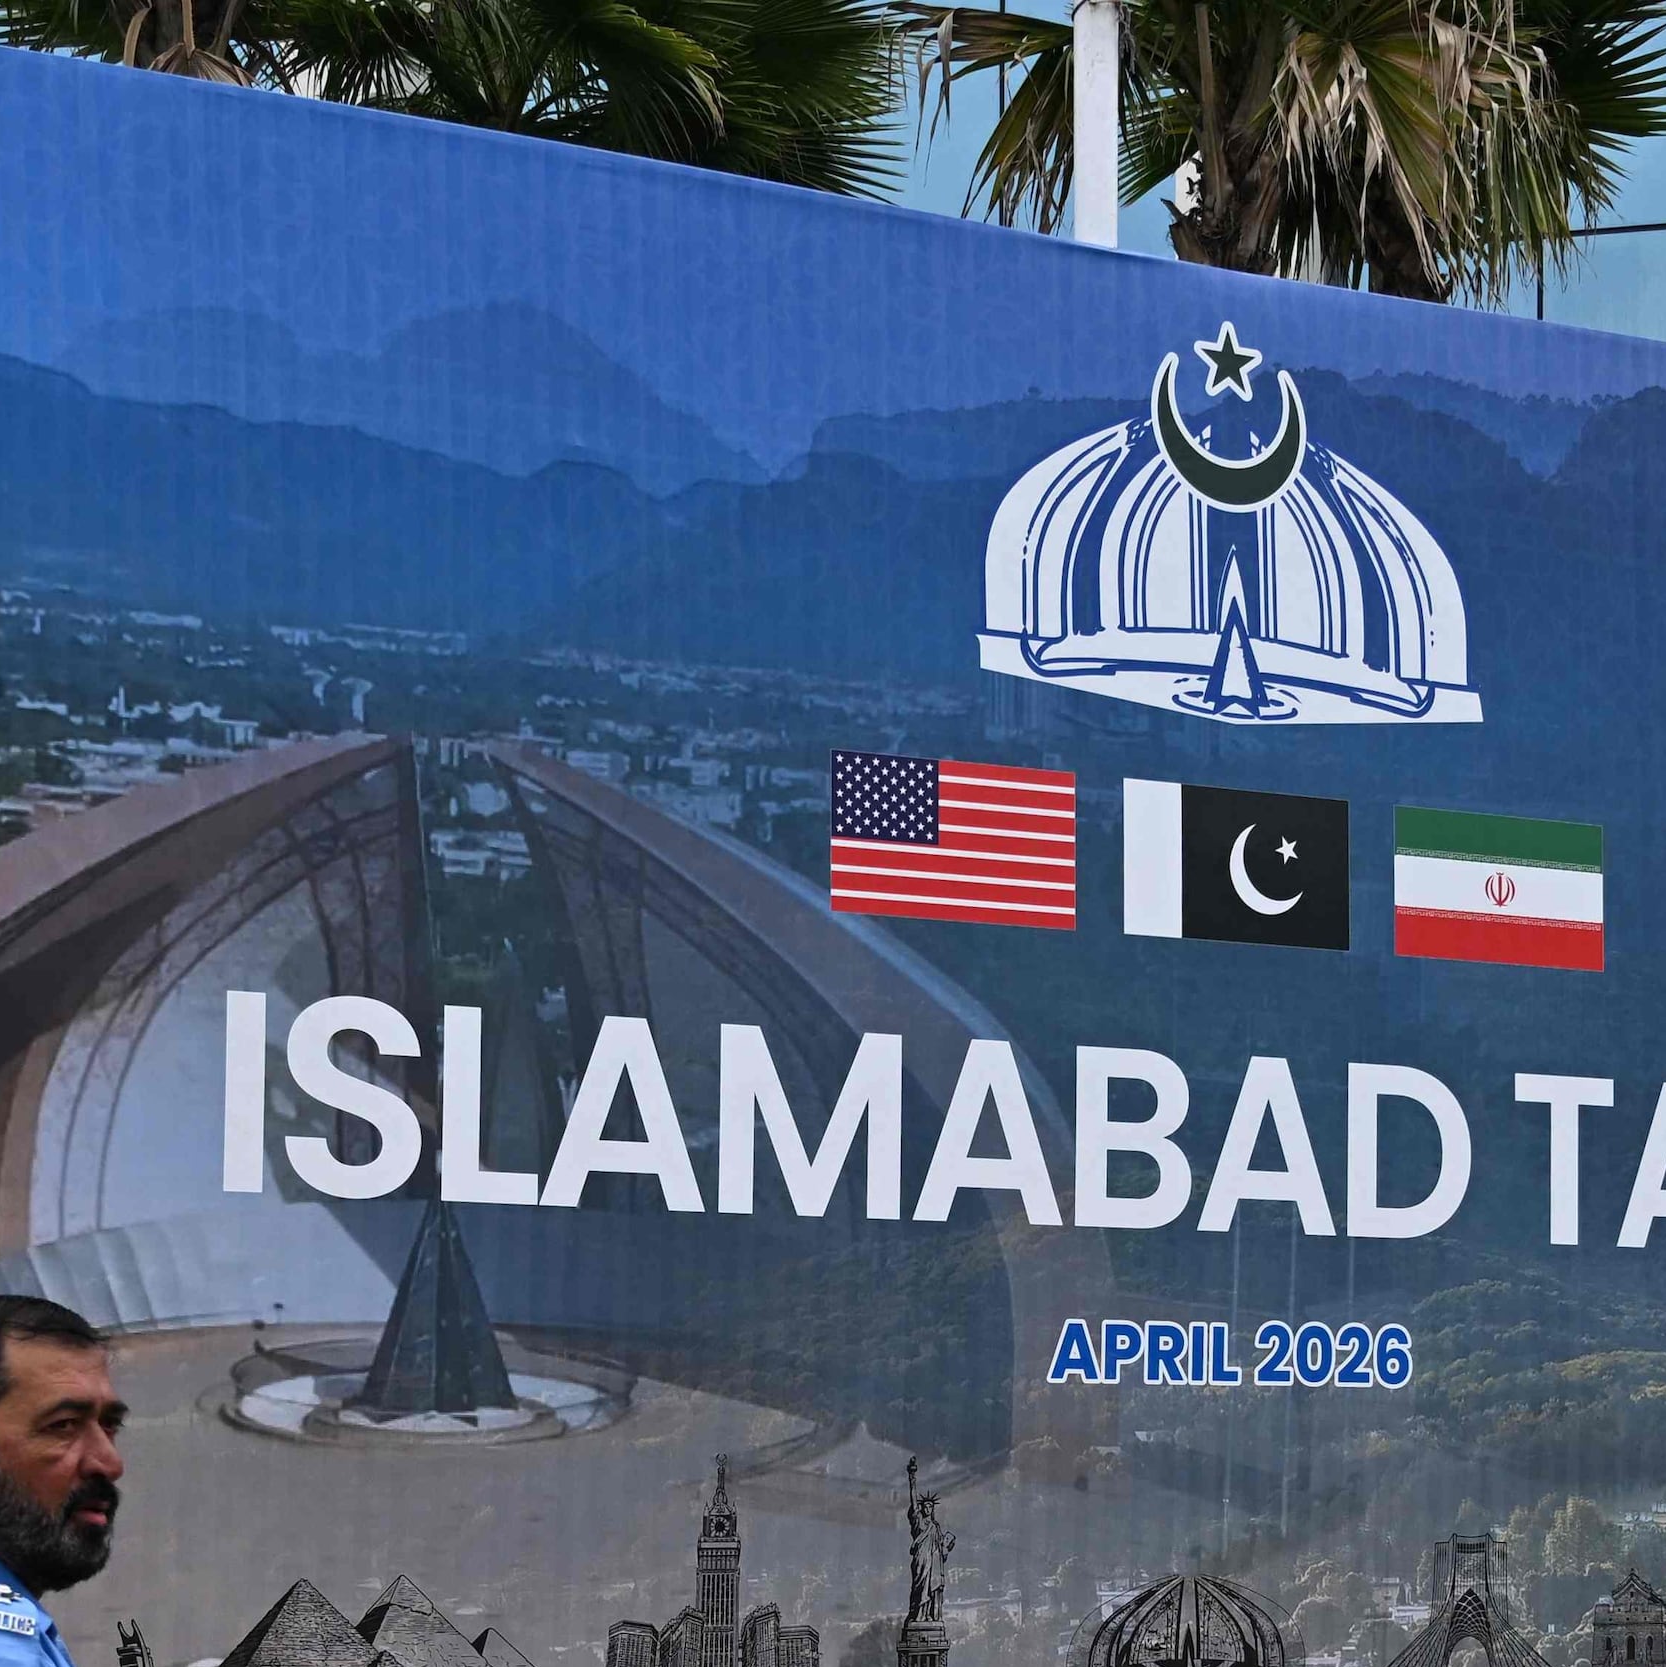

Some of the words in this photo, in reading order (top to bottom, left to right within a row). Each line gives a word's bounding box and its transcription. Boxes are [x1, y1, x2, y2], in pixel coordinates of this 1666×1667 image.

[222, 990, 1472, 1241] ISLAMABAD
[1047, 1318, 1242, 1385] APRIL
[1253, 1319, 1413, 1389] 2026
